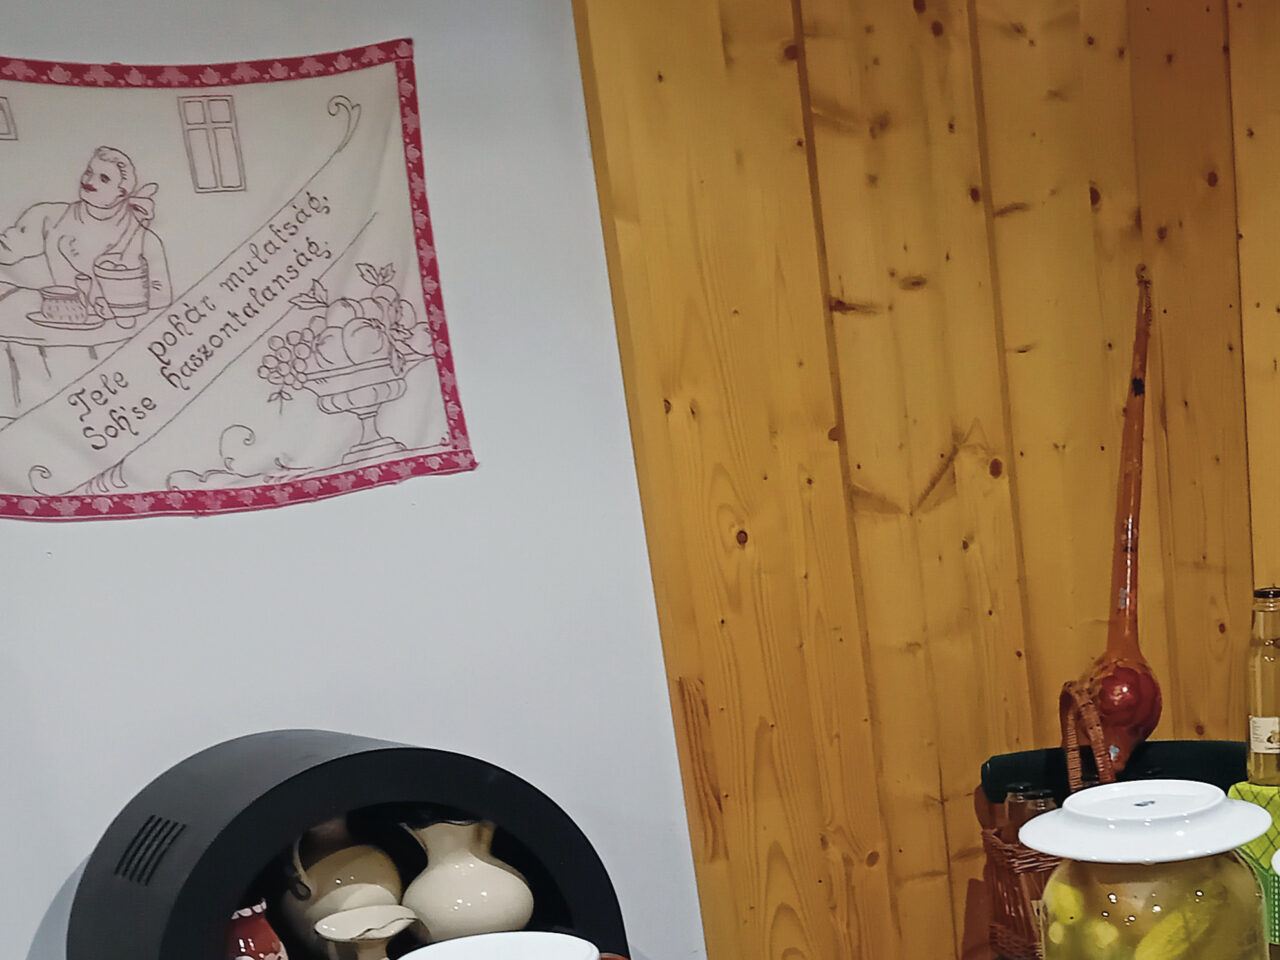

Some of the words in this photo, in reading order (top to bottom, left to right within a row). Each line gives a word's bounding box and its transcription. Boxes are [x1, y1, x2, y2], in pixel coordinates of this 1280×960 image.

[67, 371, 129, 422] Tele
[147, 295, 217, 366] pohár
[82, 397, 157, 450] Soh'se
